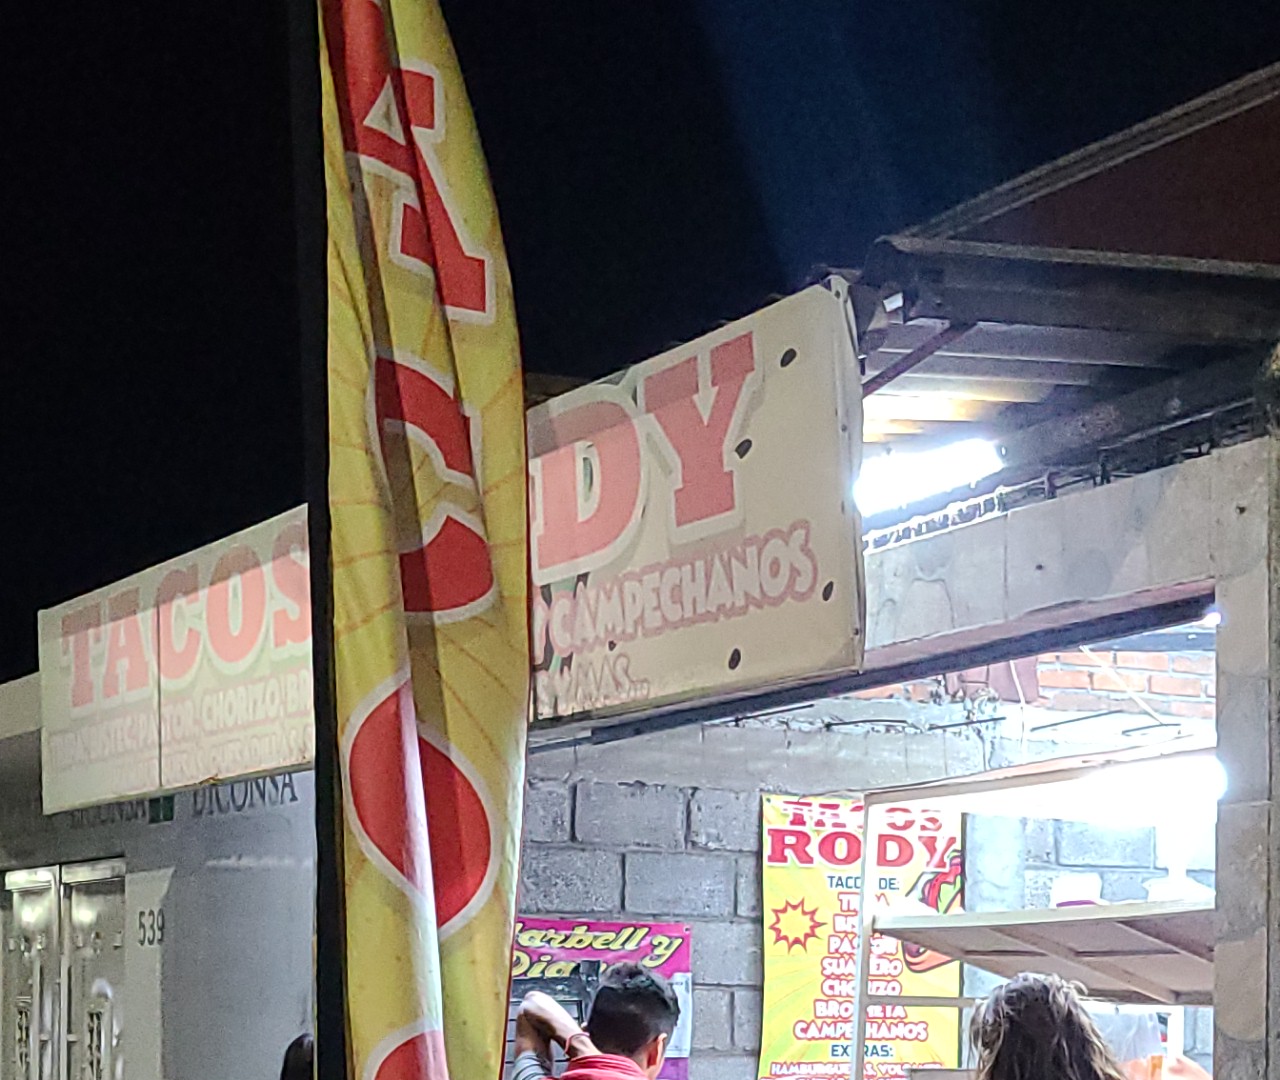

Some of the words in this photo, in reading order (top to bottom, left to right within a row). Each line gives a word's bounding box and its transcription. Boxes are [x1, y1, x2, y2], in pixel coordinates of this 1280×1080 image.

[138, 908, 165, 946] 539
[793, 1020, 928, 1040] CAMPEHANOS
[831, 1045, 894, 1057] EXRAS:
